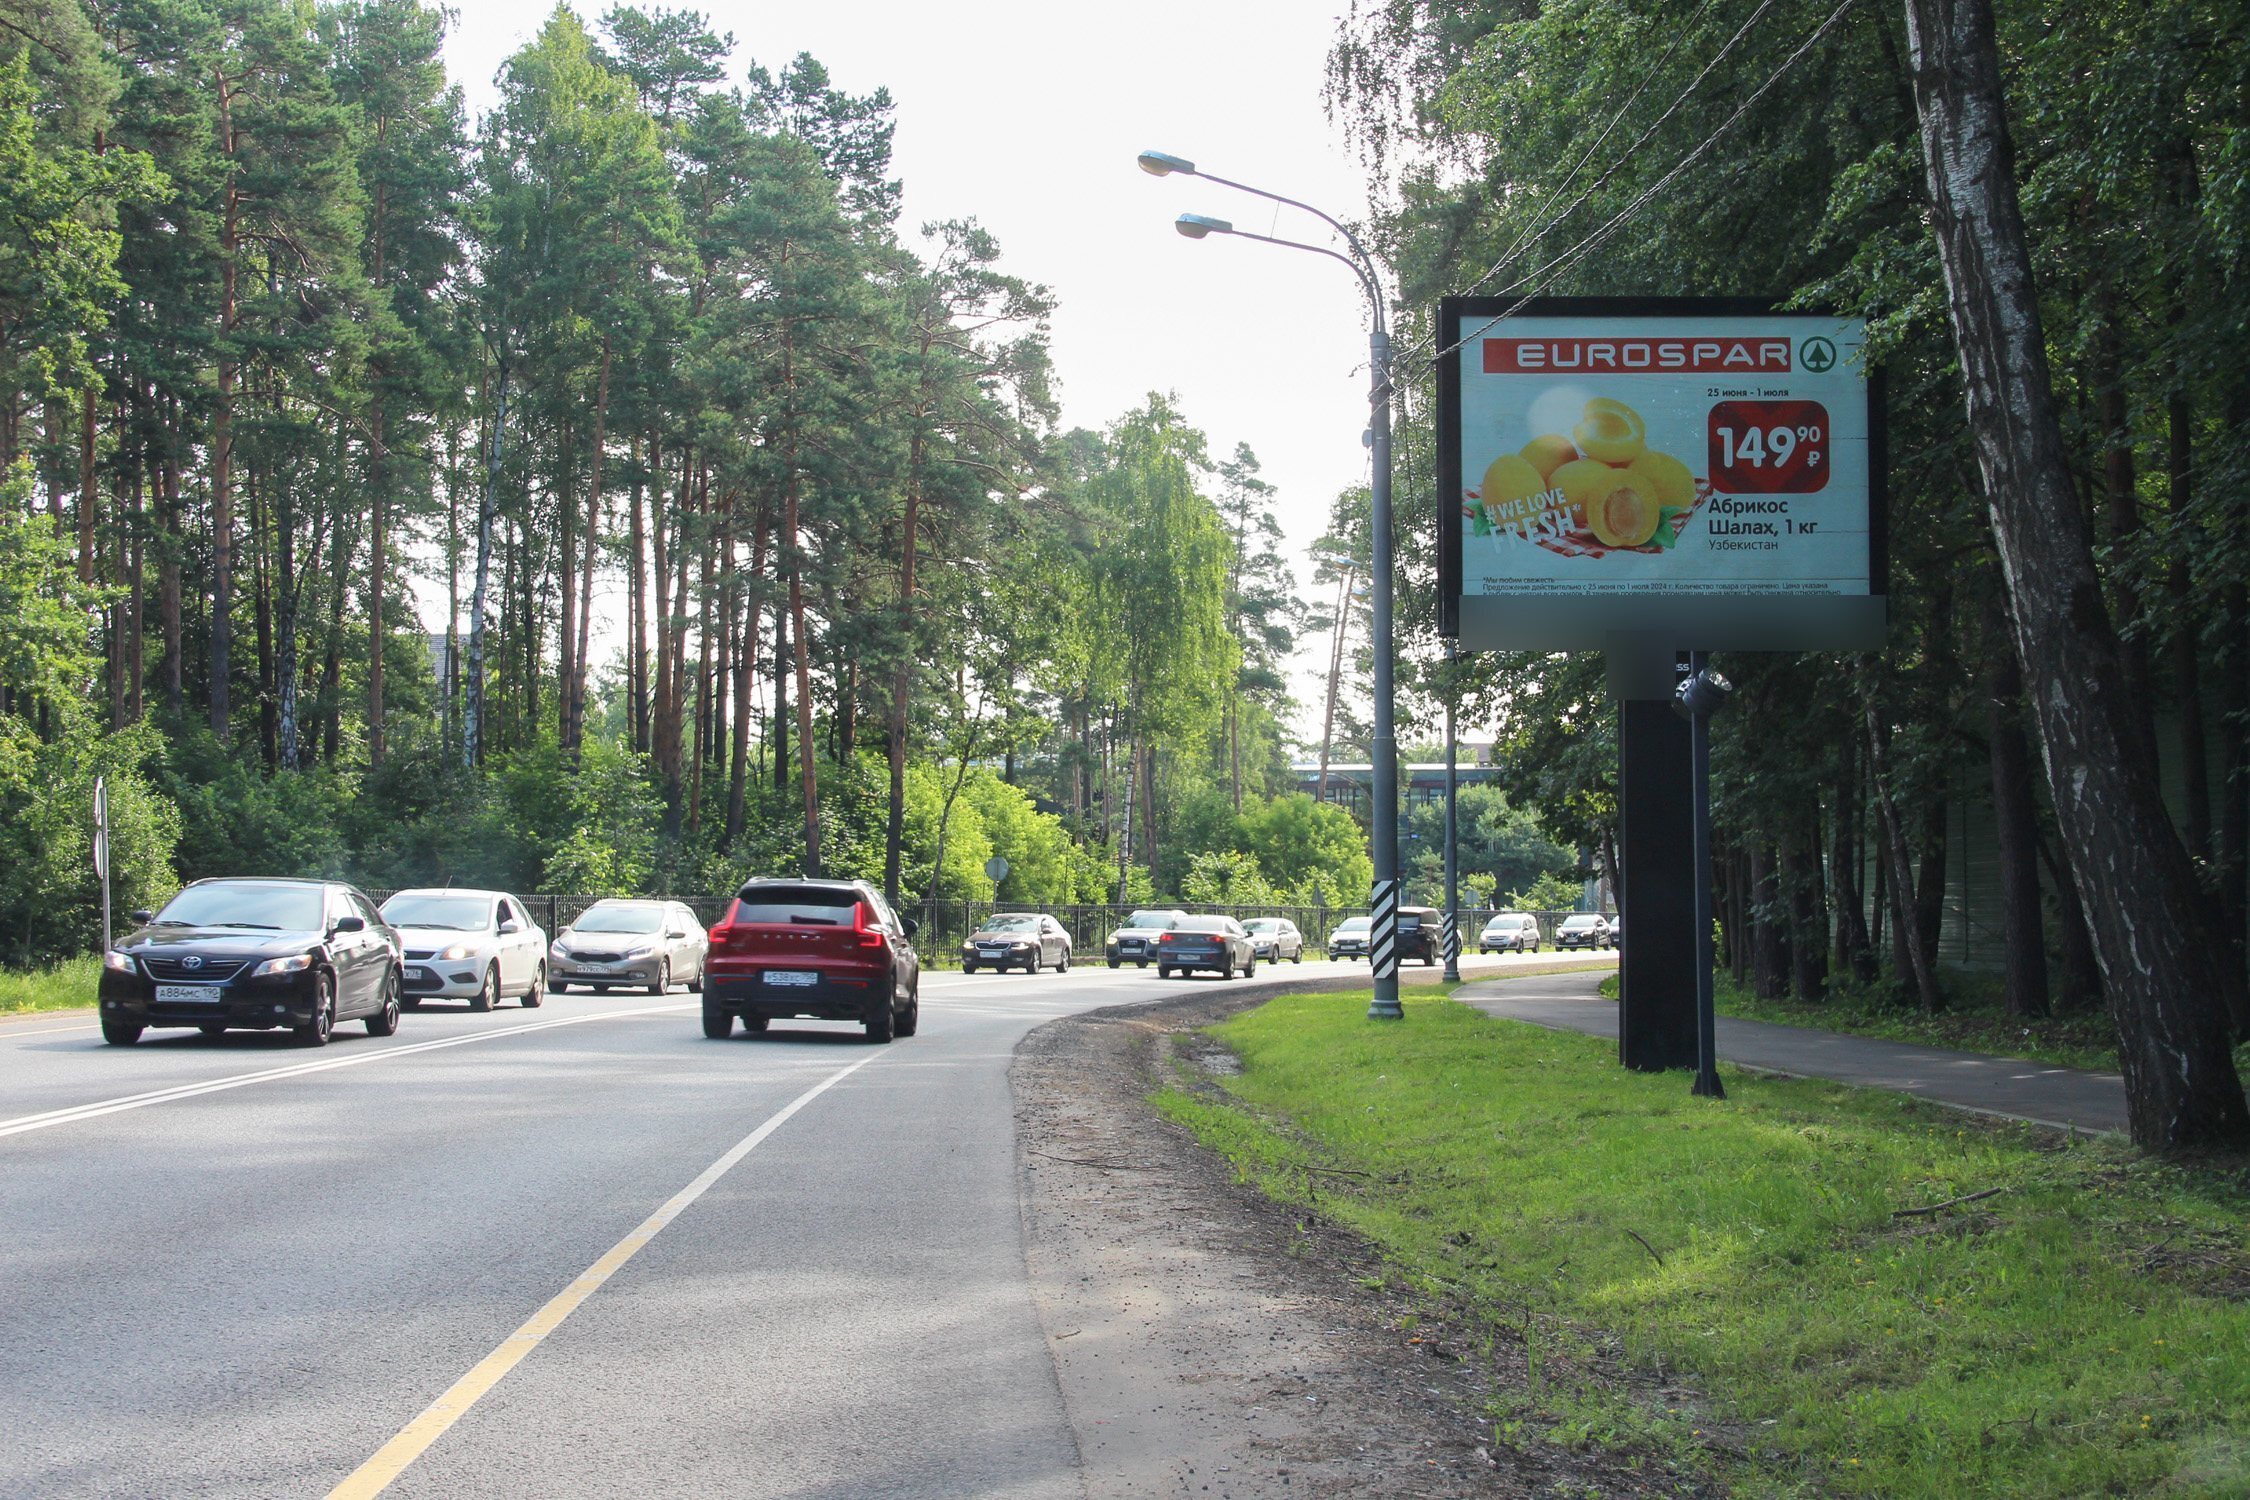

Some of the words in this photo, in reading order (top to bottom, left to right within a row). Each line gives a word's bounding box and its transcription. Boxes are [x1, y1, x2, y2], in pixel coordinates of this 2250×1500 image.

[1516, 343, 1788, 367] EUROSPAR
[1707, 388, 1719, 397] 25
[1757, 388, 1761, 396] 1
[1717, 426, 1796, 468] 149
[1797, 426, 1821, 442] 90
[1526, 487, 1567, 512] LOVE
[1708, 498, 1788, 517] Абрикос
[1709, 519, 1779, 537] Шалах,
[1785, 519, 1792, 534] 1
[1799, 522, 1818, 534] кг
[1708, 539, 1779, 550] Узбекистан
